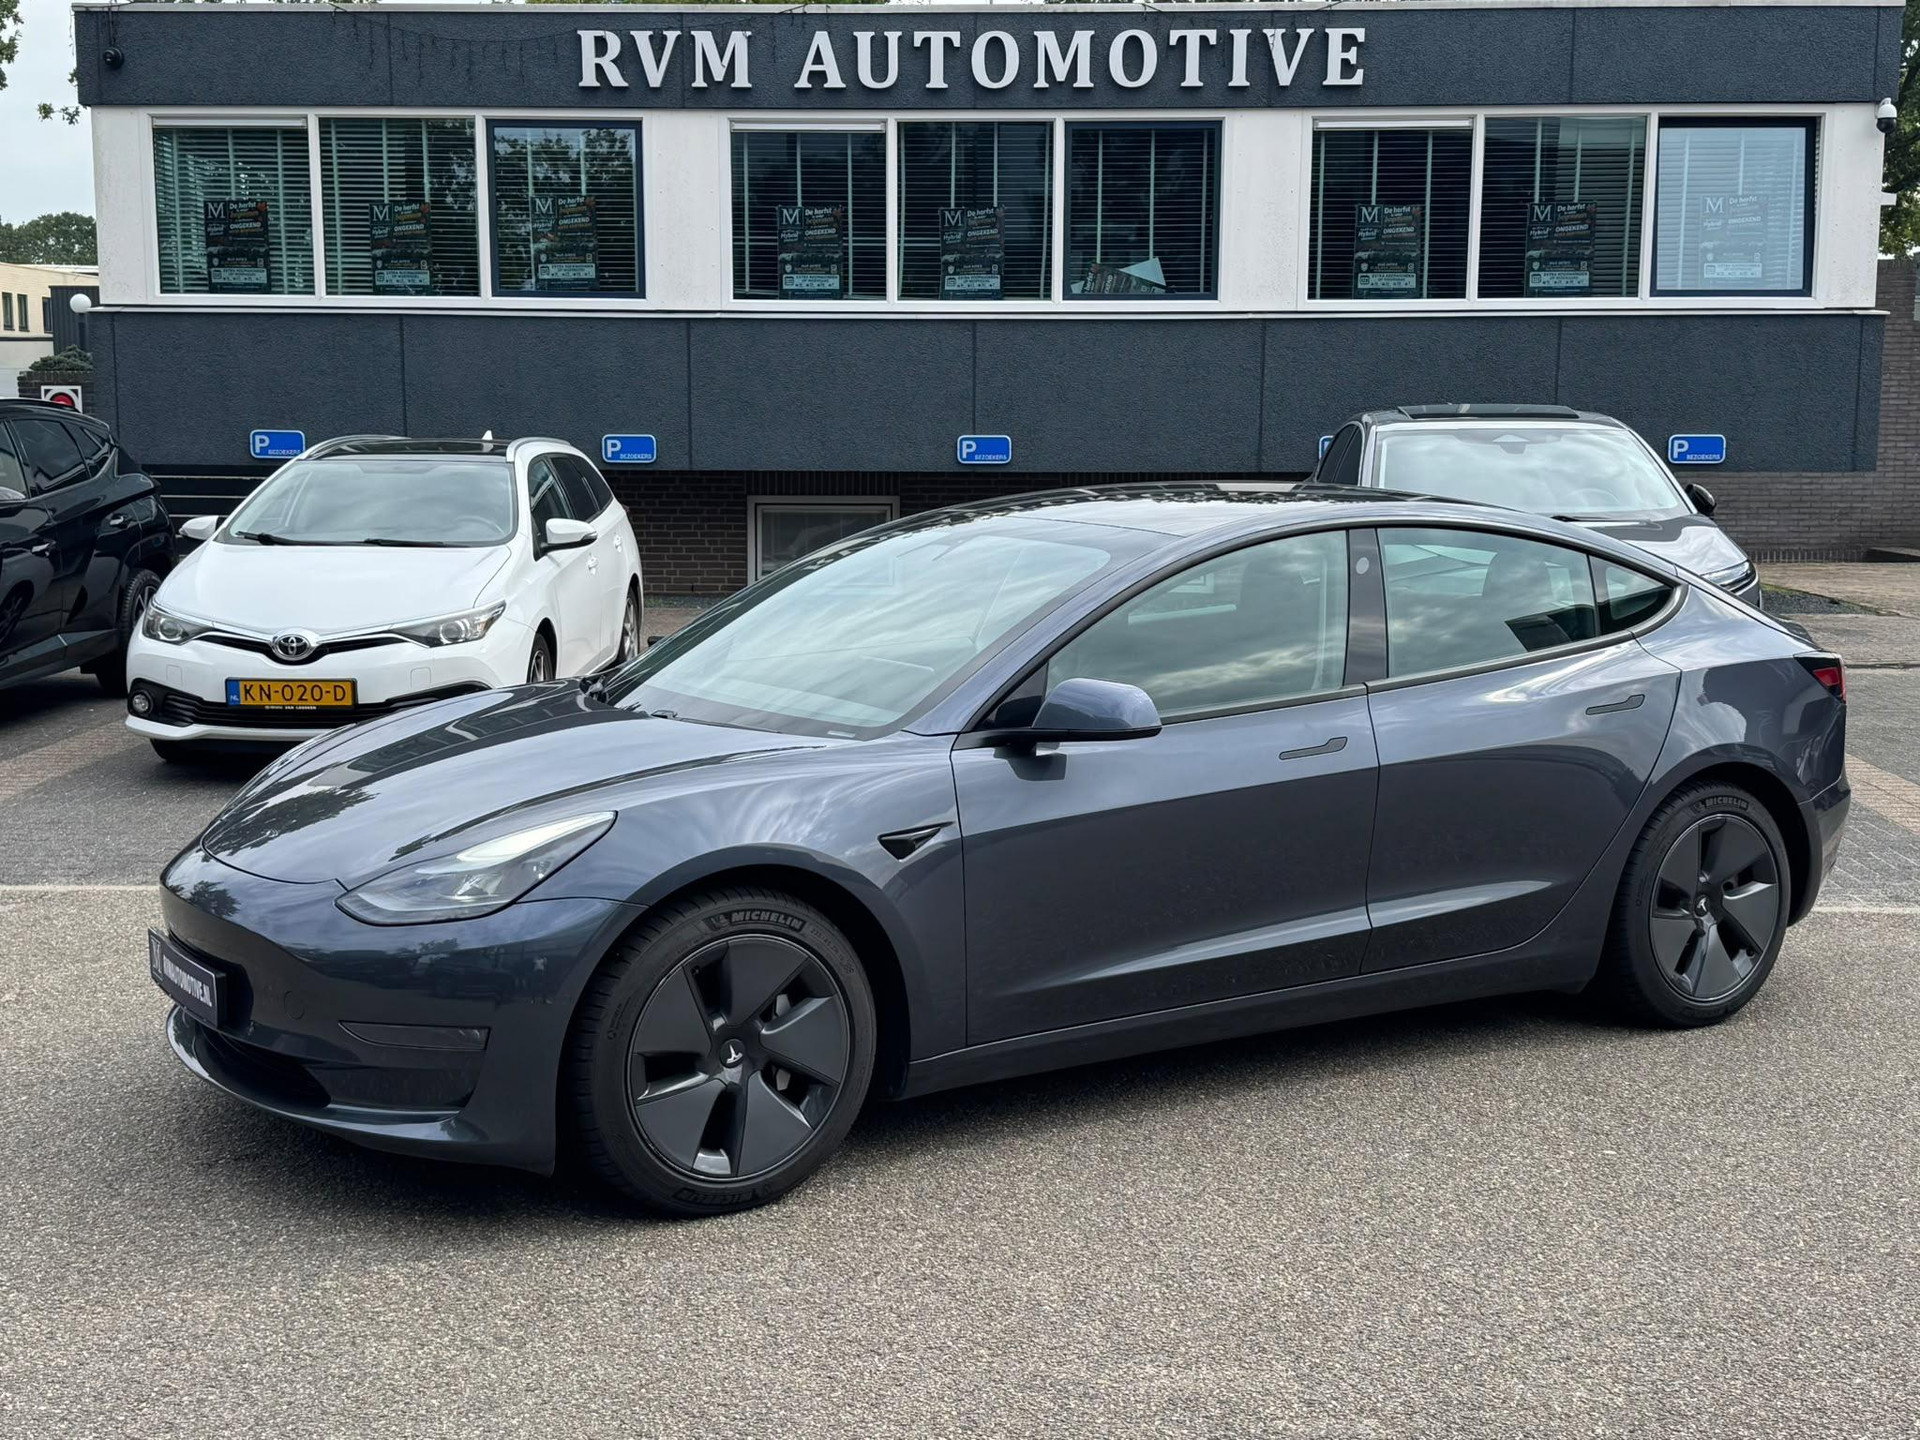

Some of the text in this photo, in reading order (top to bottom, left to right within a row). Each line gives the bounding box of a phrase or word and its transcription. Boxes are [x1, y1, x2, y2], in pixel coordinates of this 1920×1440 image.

[577, 28, 1366, 88] RVM AUTOMOTIVE
[207, 202, 225, 218] M
[372, 205, 390, 221] M
[534, 198, 554, 214] M
[1532, 205, 1553, 221] M
[1704, 197, 1724, 213] M
[782, 208, 800, 225] M
[944, 210, 963, 226] M
[1360, 206, 1380, 223] M
[1555, 224, 1589, 232] ONGEKEND
[255, 435, 269, 453] P
[607, 440, 621, 458] P
[962, 441, 977, 459] P
[1673, 440, 1689, 459] P
[243, 684, 346, 702] KN-020-D
[1705, 796, 1748, 810] MICHELIN
[731, 911, 804, 930] MICHELIN
